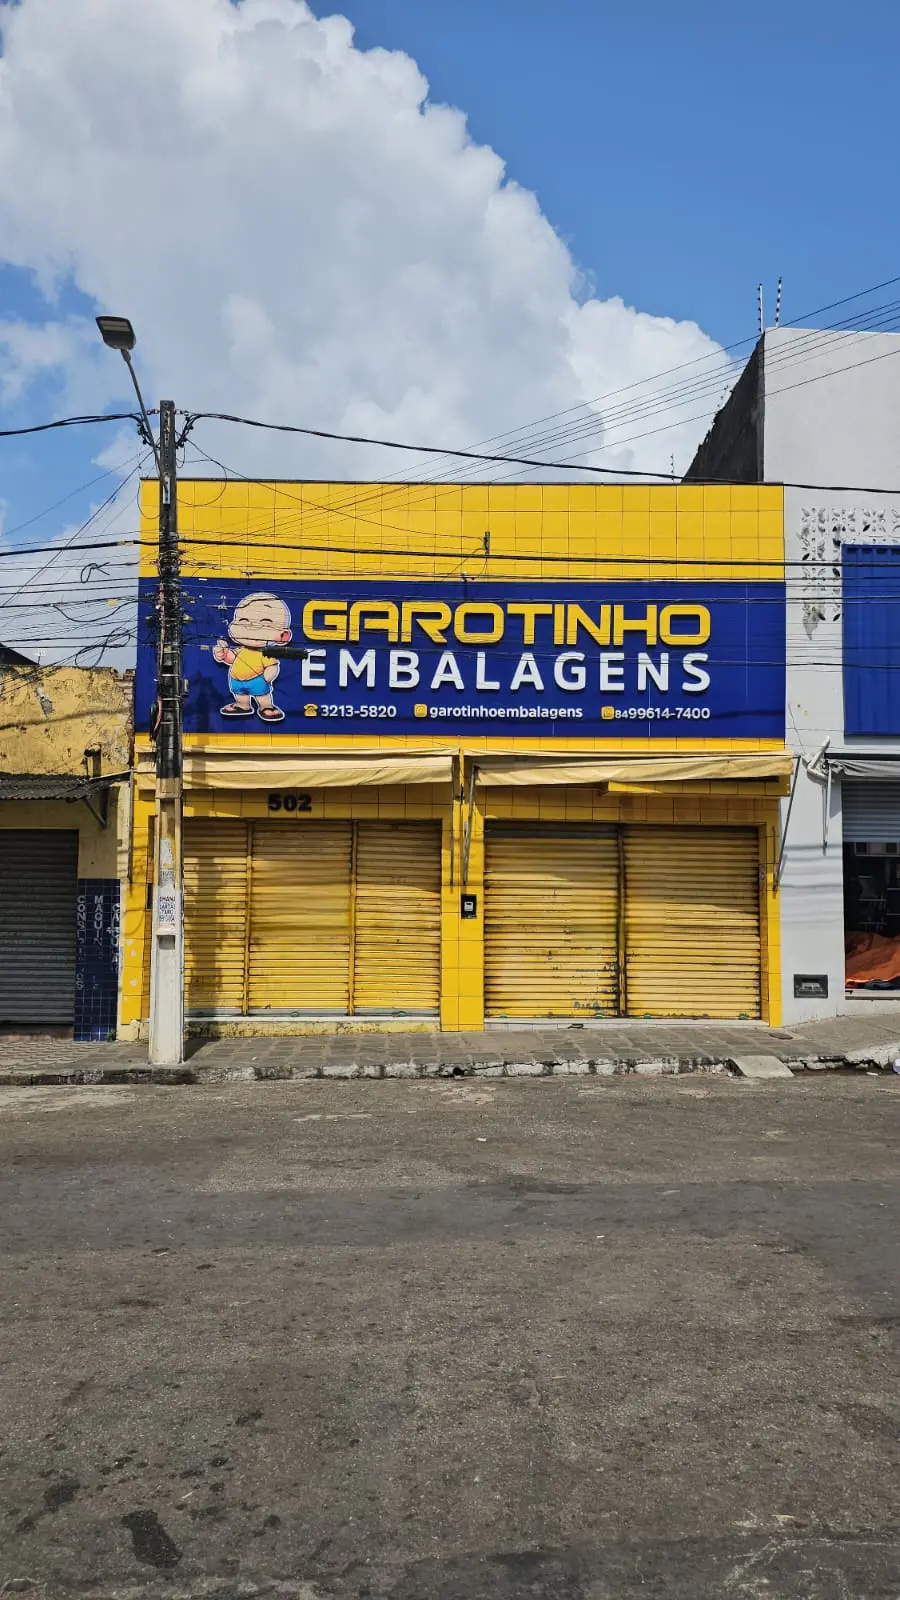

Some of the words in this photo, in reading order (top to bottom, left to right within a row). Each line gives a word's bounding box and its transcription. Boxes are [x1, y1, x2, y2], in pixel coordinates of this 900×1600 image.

[303, 600, 711, 645] GAROTINHO
[301, 648, 711, 692] EMBALAGENS
[320, 703, 397, 718] 3213-5820
[429, 705, 584, 720] garotinhoembalagens
[268, 794, 312, 812] 502
